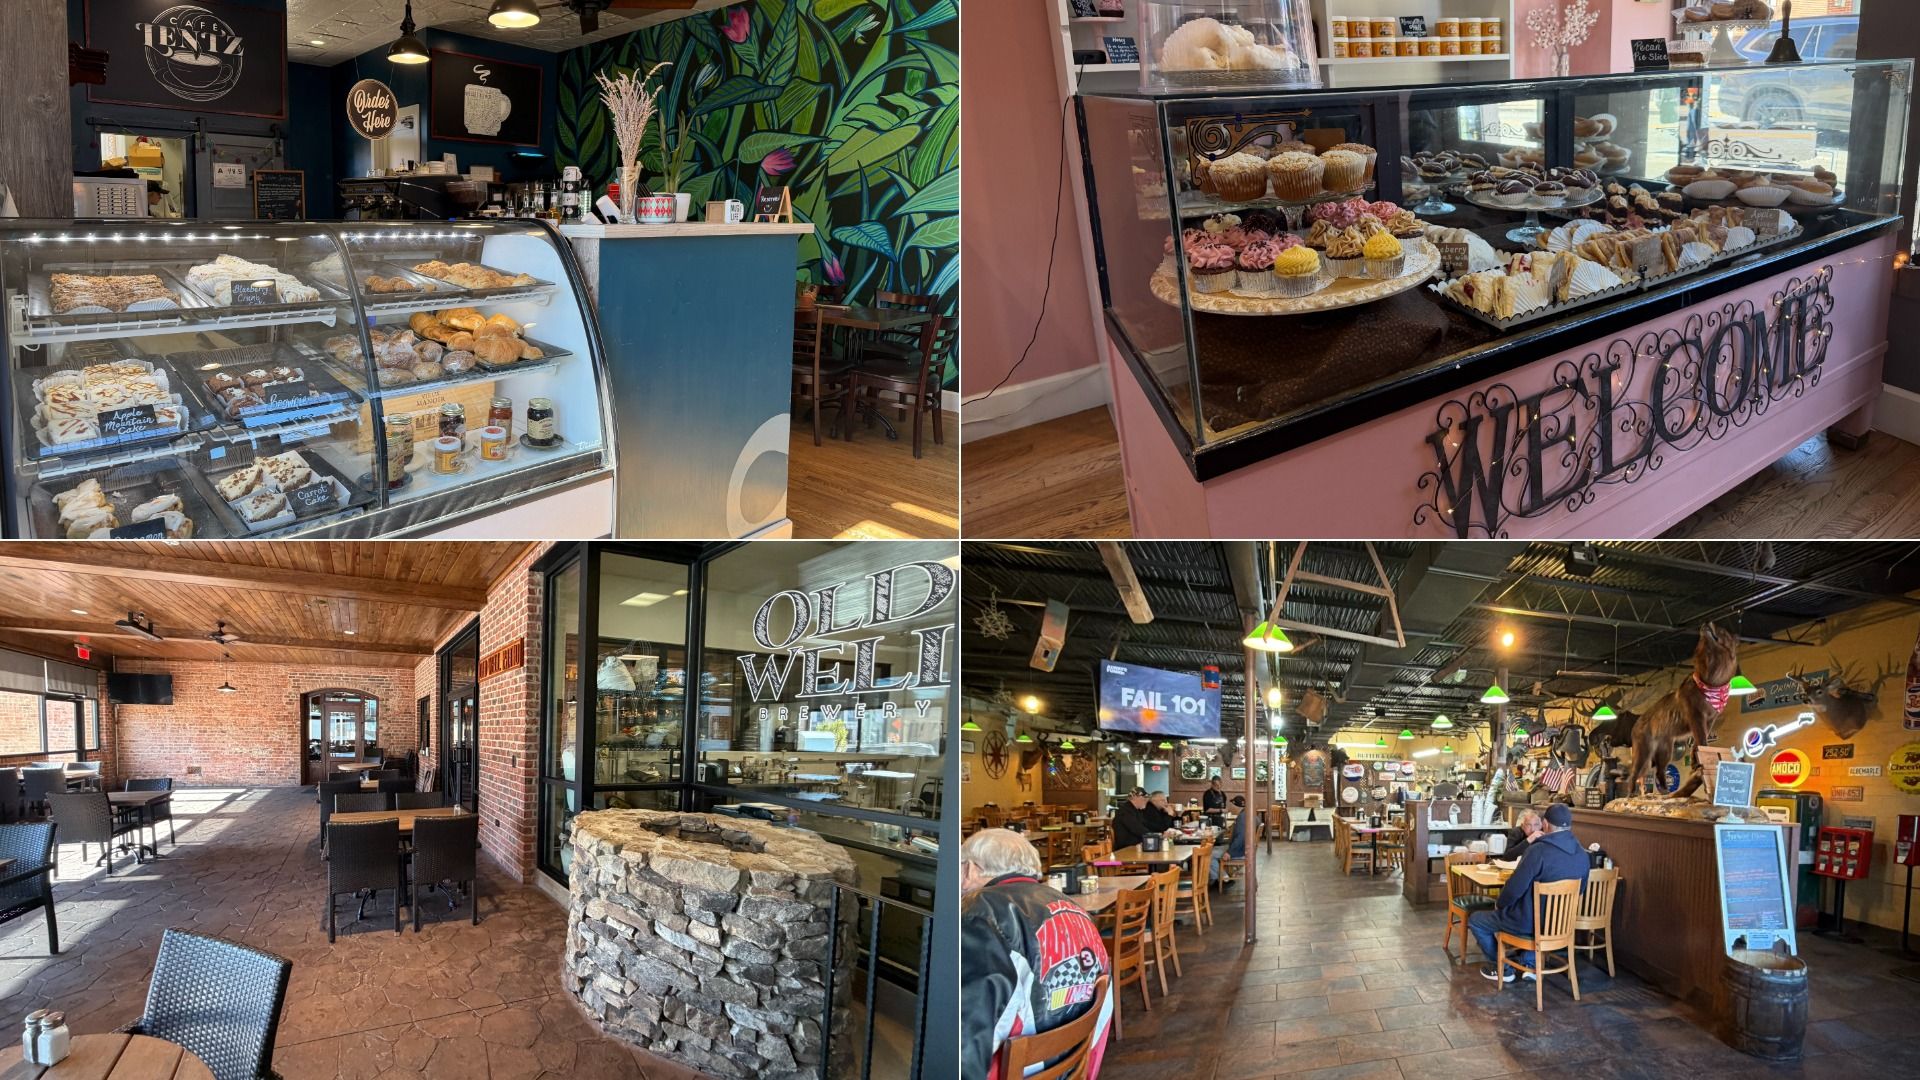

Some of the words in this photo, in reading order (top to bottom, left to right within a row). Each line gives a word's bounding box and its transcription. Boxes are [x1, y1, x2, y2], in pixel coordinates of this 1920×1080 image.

[135, 22, 245, 57] LENTZ
[1633, 41, 1662, 51] Pecan
[1634, 52, 1647, 61] Pie
[354, 89, 389, 113] Order
[362, 110, 390, 132] Here
[1414, 265, 1834, 539] WELCOME
[113, 408, 143, 420] Apple
[104, 416, 155, 432] Mountain
[118, 425, 146, 435] Cake
[297, 484, 328, 500] Carrot
[305, 494, 330, 505] Cake
[753, 560, 956, 649] OLD
[1121, 687, 1168, 712] FAIL
[1171, 694, 1206, 716] 101
[759, 700, 931, 721] BREWERY
[1771, 761, 1801, 775] AMOCO
[1081, 950, 1094, 968] 3
